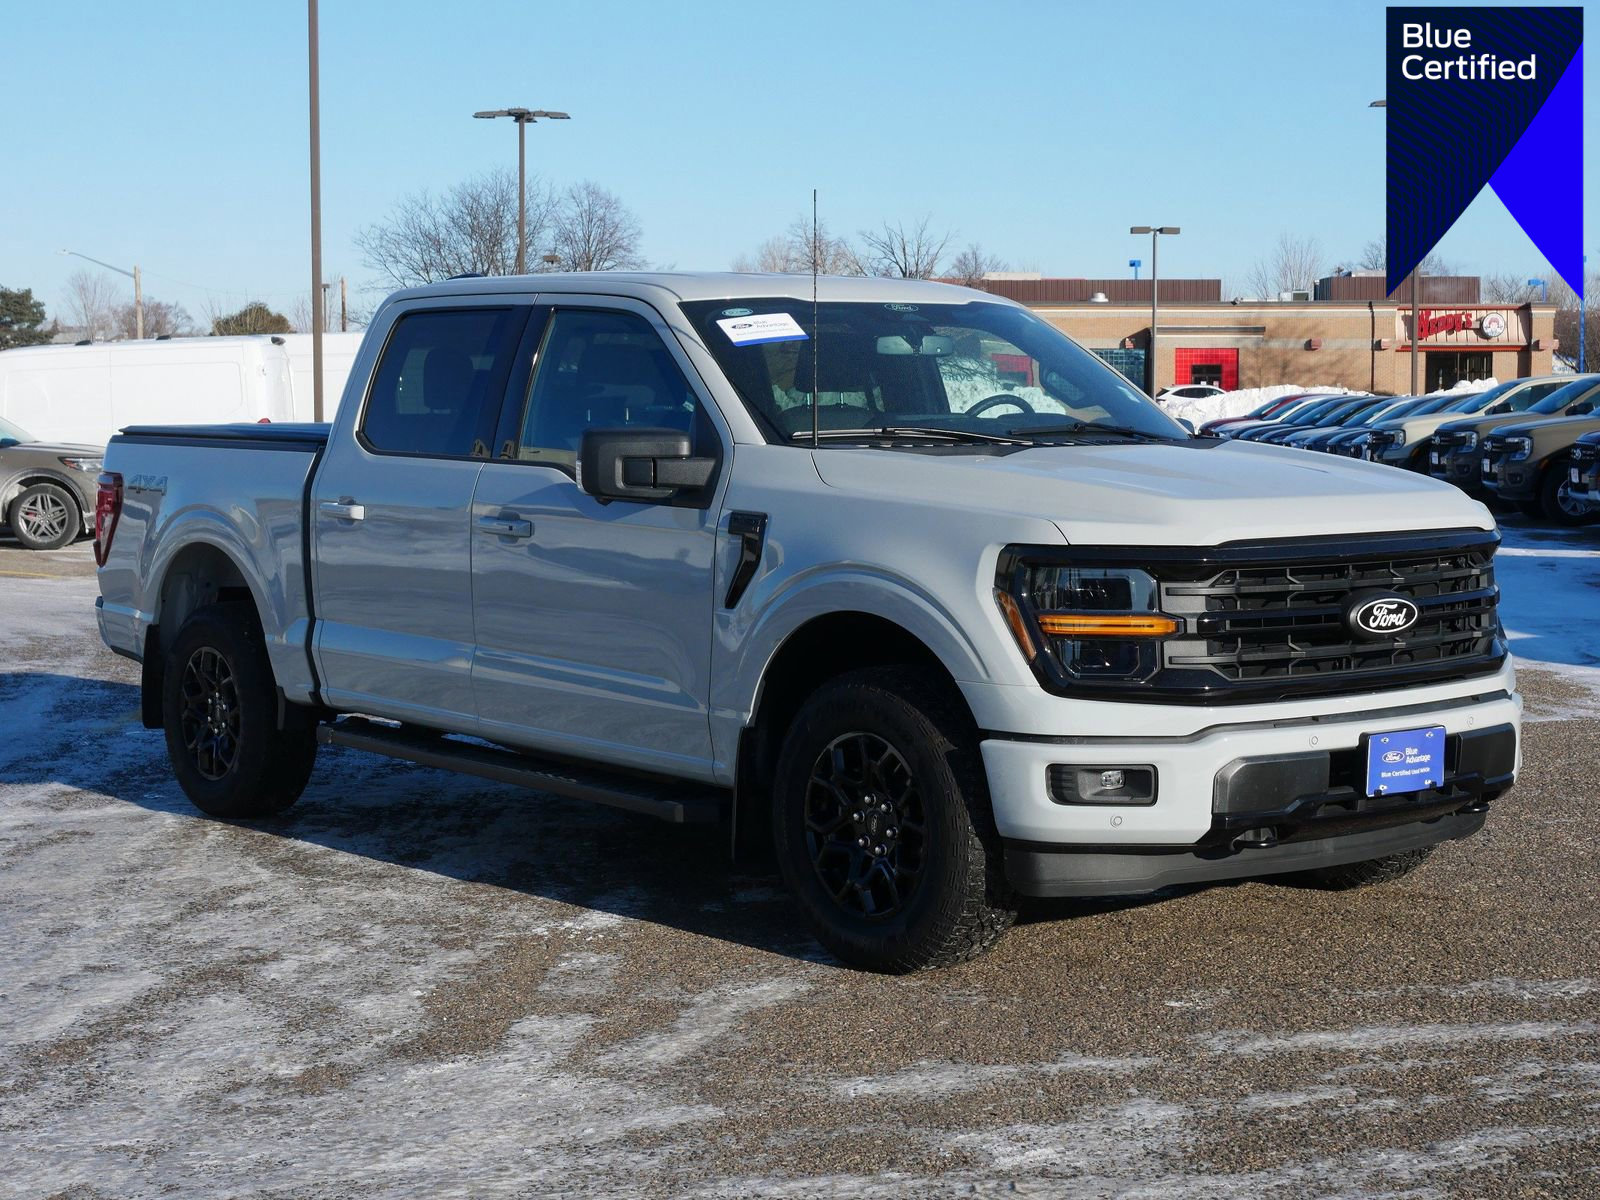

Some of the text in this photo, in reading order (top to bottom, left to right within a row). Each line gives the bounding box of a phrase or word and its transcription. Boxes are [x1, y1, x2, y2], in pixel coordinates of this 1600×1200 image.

[1369, 603, 1407, 628] Ford
[1405, 747, 1418, 755] Blue
[1405, 754, 1431, 764] Advantage
